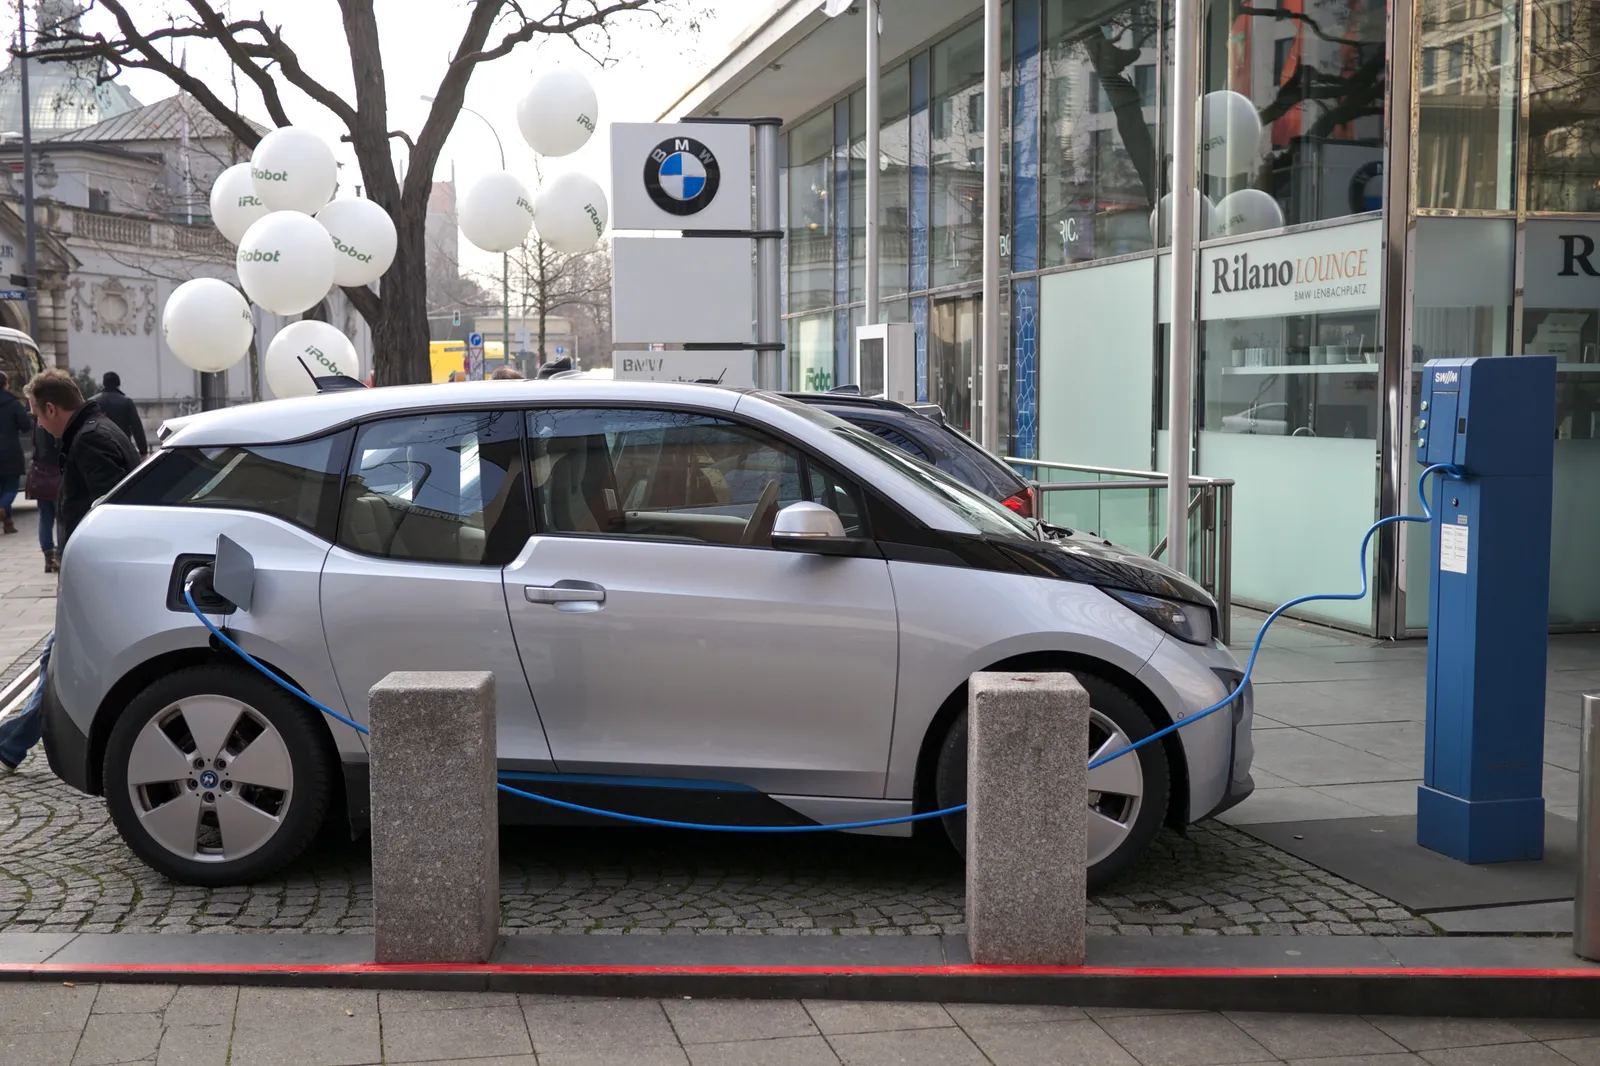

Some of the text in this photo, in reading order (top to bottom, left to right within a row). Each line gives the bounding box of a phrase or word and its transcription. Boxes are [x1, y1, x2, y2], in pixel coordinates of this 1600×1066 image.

[651, 139, 714, 165] BMW
[251, 167, 288, 182] Robot
[238, 195, 263, 207] iRo
[1060, 217, 1079, 242] RIC.
[240, 249, 281, 262] Robot
[329, 233, 373, 264] Robot
[1212, 249, 1368, 294] Rilano LOUNGE
[1294, 283, 1367, 301] BMW LENBACHPLATZ
[623, 358, 664, 372] BMW
